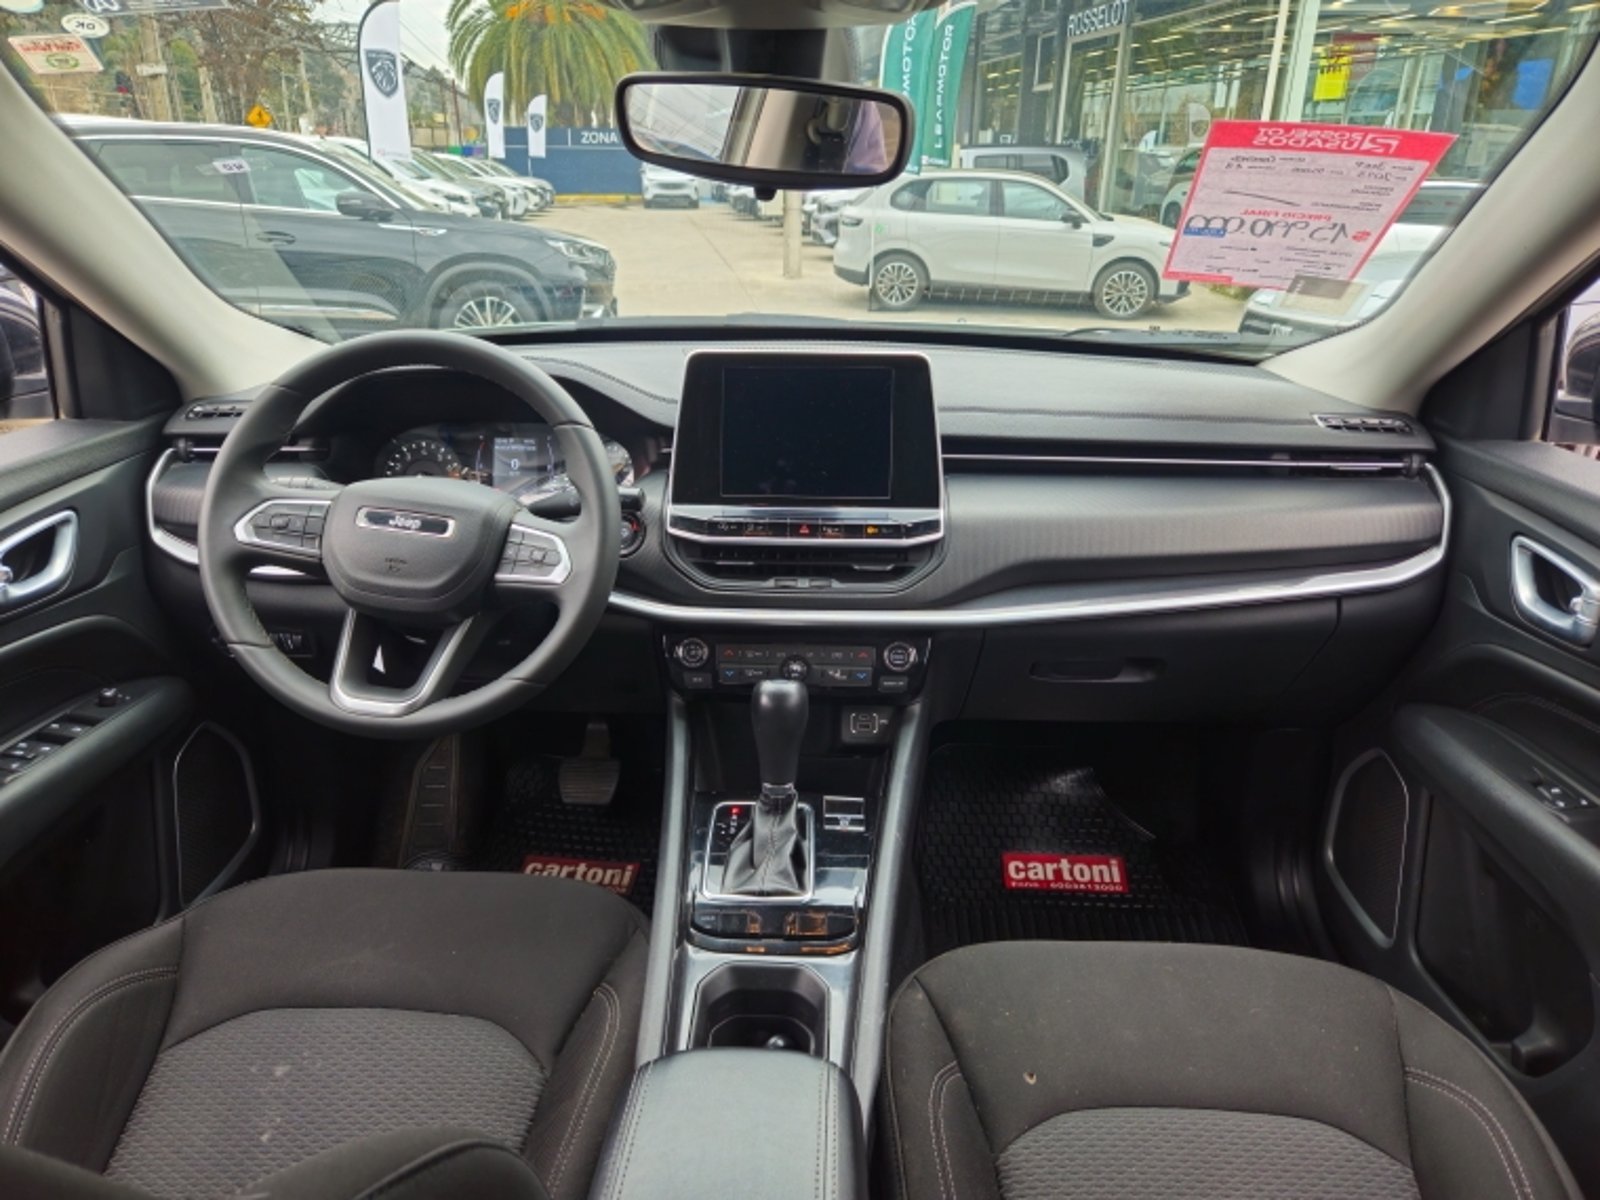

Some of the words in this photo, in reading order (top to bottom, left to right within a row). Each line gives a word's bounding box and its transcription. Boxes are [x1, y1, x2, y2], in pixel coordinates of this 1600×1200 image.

[1067, 0, 1128, 37] ROSSELOT
[934, 24, 955, 149] LEAPMOTOR
[581, 131, 618, 144] ZONA
[511, 458, 519, 470] 0
[388, 515, 422, 529] Jeep
[524, 862, 633, 887] cartoni
[1008, 858, 1121, 882] cartoni
